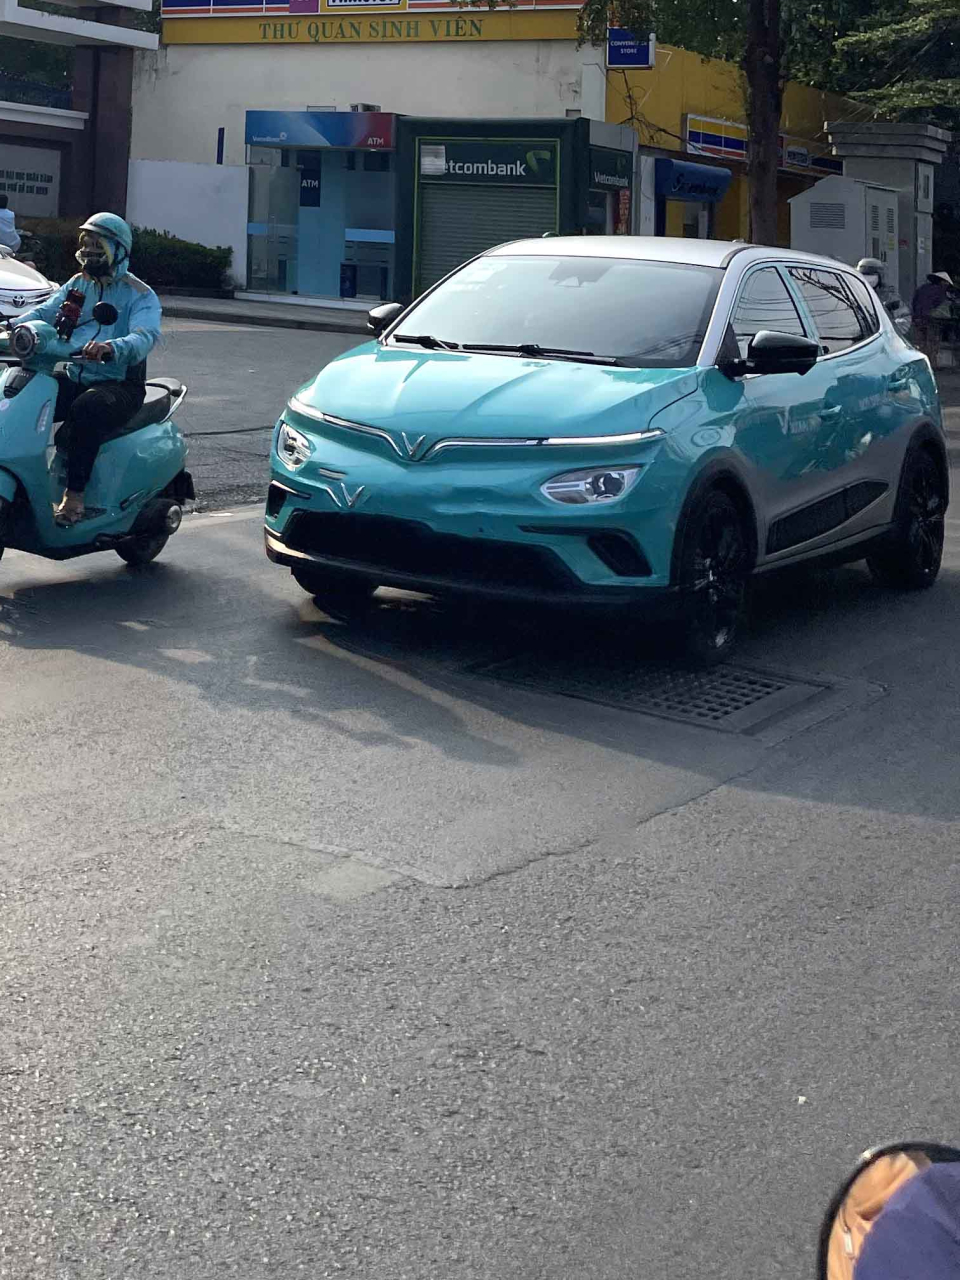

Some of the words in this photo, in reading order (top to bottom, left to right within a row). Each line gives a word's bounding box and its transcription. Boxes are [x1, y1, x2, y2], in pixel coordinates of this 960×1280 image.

[258, 20, 302, 40] THƯ
[307, 18, 362, 43] QUÁN
[368, 19, 421, 39] SINH
[428, 16, 484, 38] VIÊN
[367, 137, 384, 146] ATM
[301, 179, 319, 188] ATM
[594, 171, 629, 187] Vietcombank
